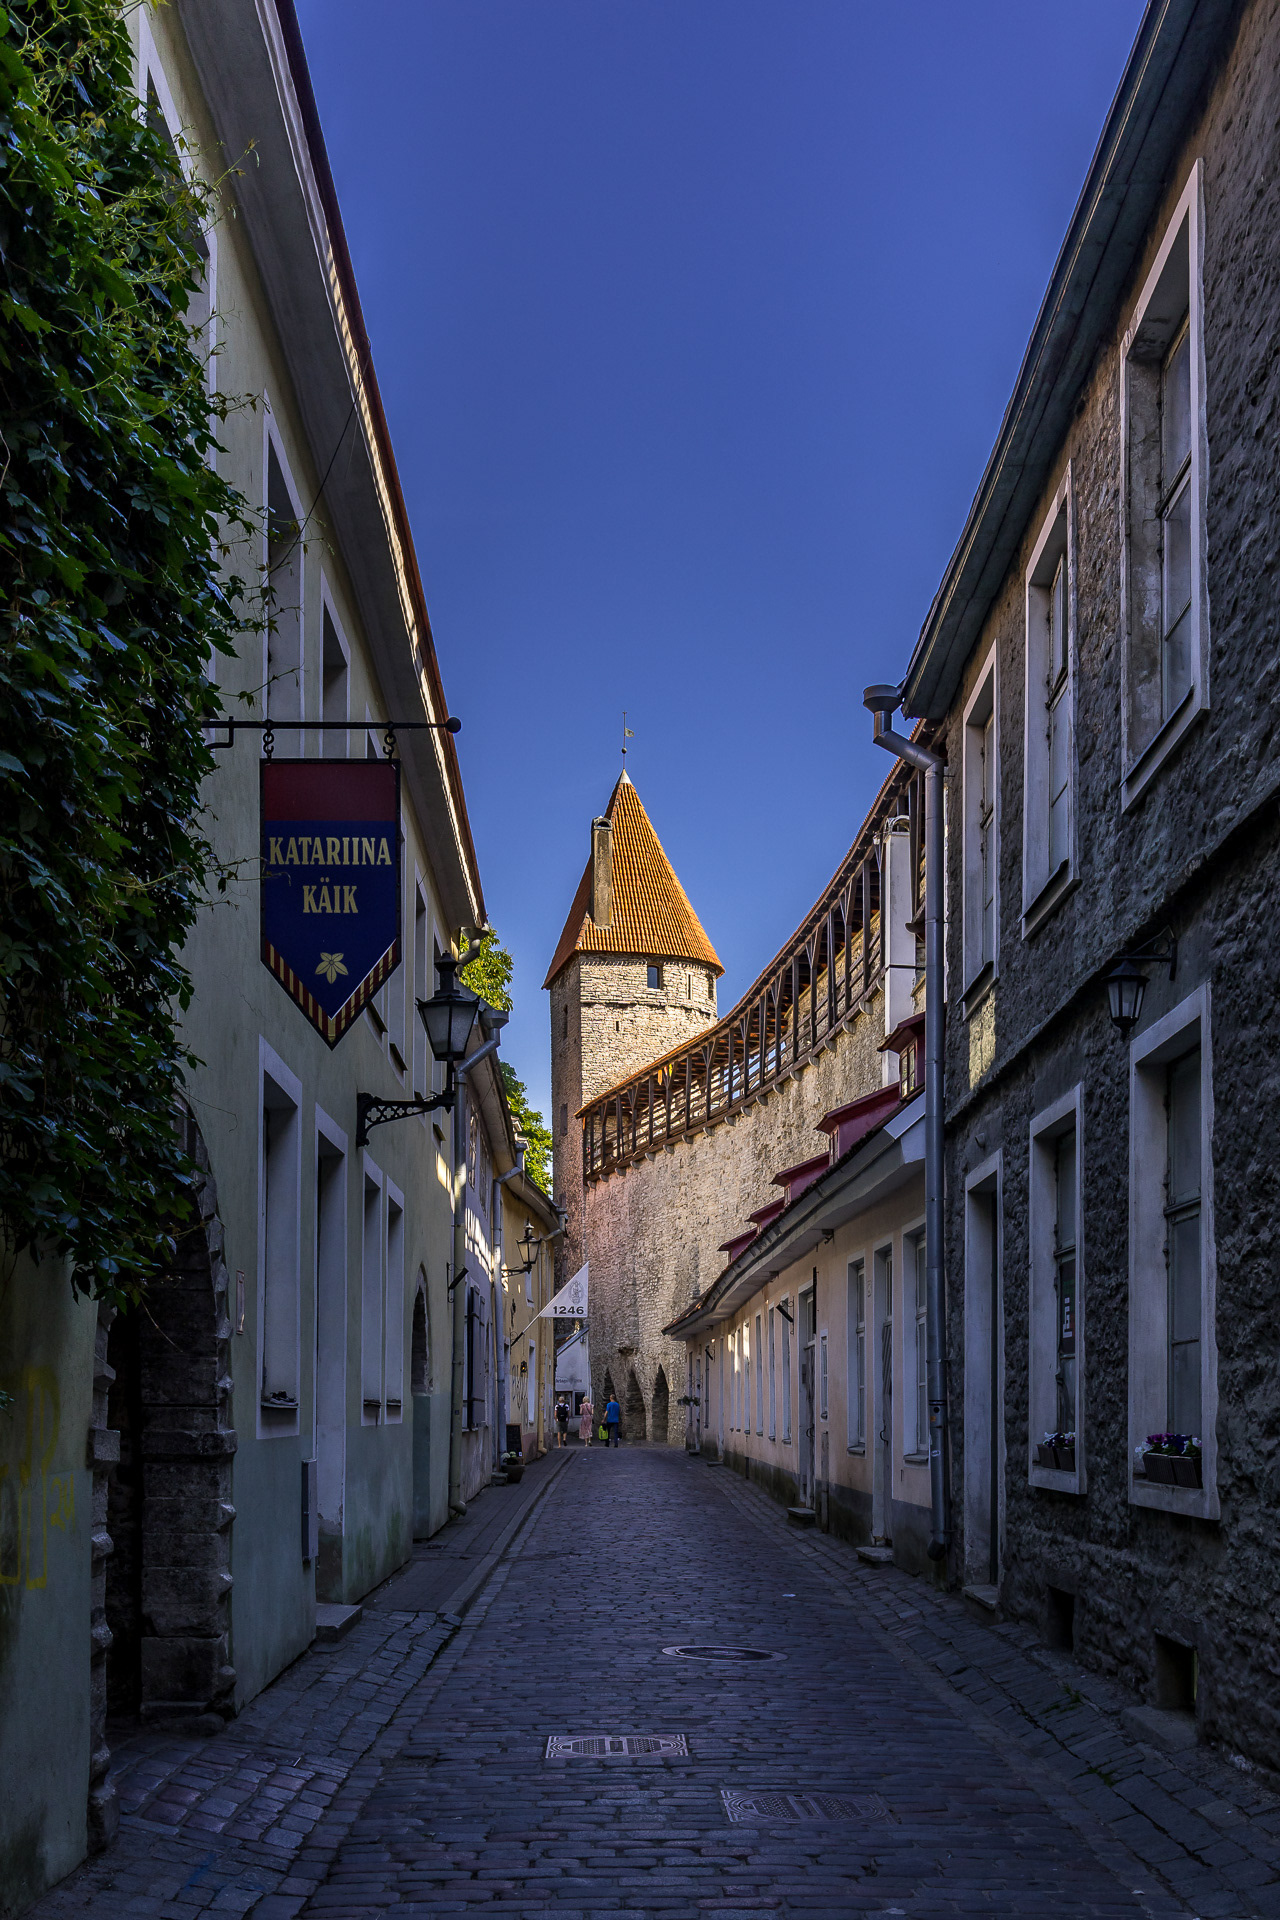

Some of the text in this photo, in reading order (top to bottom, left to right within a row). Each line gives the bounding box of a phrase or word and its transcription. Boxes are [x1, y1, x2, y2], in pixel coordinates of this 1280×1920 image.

[269, 837, 392, 865] KATARIINA
[302, 877, 358, 913] KÄIK
[553, 1306, 584, 1315] 1246
